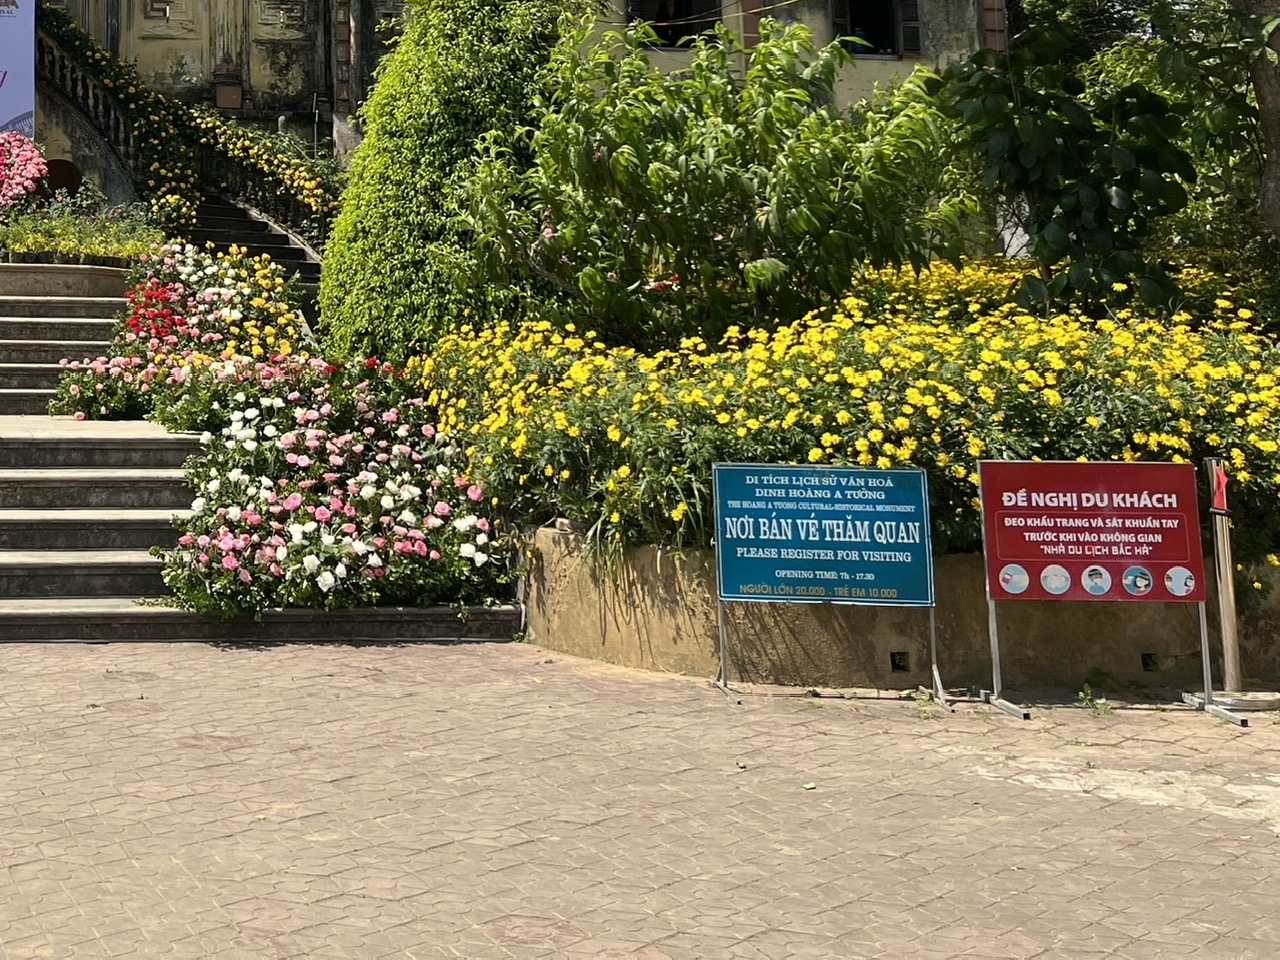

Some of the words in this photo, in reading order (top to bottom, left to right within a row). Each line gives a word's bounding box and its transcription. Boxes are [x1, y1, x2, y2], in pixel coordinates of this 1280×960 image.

[746, 476, 758, 484] DI
[761, 474, 789, 484] TÍCH
[792, 476, 819, 486] LỊCH
[822, 475, 838, 486] SỬ
[839, 477, 865, 486] VĂN
[868, 477, 894, 487] HOÁ
[755, 489, 786, 497] DINH
[789, 488, 831, 498] HOÀNG
[845, 488, 886, 499] TƯỞNG
[1002, 488, 1028, 506] ĐỀ
[1031, 492, 1078, 511] NGHỊ
[1082, 493, 1108, 507] DU
[1113, 491, 1177, 508] KHÁCH
[727, 500, 741, 508] THE
[725, 514, 755, 539] NƠI
[758, 511, 792, 540] BÁN
[796, 512, 820, 540] VÉ
[822, 514, 870, 542] THĂM
[874, 521, 920, 544] QUAN
[1004, 518, 1025, 526] ĐEO
[1056, 518, 1089, 527] TRANG
[1090, 517, 1104, 527] VÀ
[1106, 517, 1123, 528] SÁT
[1161, 520, 1179, 528] TAY
[1024, 531, 1058, 541] TRƯỚC
[1060, 532, 1076, 542] KHI
[1078, 532, 1098, 542] VÀO
[1100, 532, 1135, 542] KHÔNG
[1137, 534, 1162, 543] GIAN
[736, 548, 778, 558] PLEASE
[781, 548, 834, 560] REGISTER
[837, 550, 859, 560] FOR
[862, 551, 912, 562] VISITING
[1068, 546, 1082, 554] DU
[1085, 545, 1109, 556] LỊCH
[775, 570, 813, 578] OPENING
[815, 571, 838, 579] TIME:
[840, 572, 849, 580] 7h
[739, 582, 771, 594] NGƯỜI
[774, 583, 793, 594] LỚN
[796, 586, 825, 595] 20.000
[834, 584, 849, 596] TRẺ
[852, 588, 865, 596] EM
[869, 588, 897, 598] 10.000
